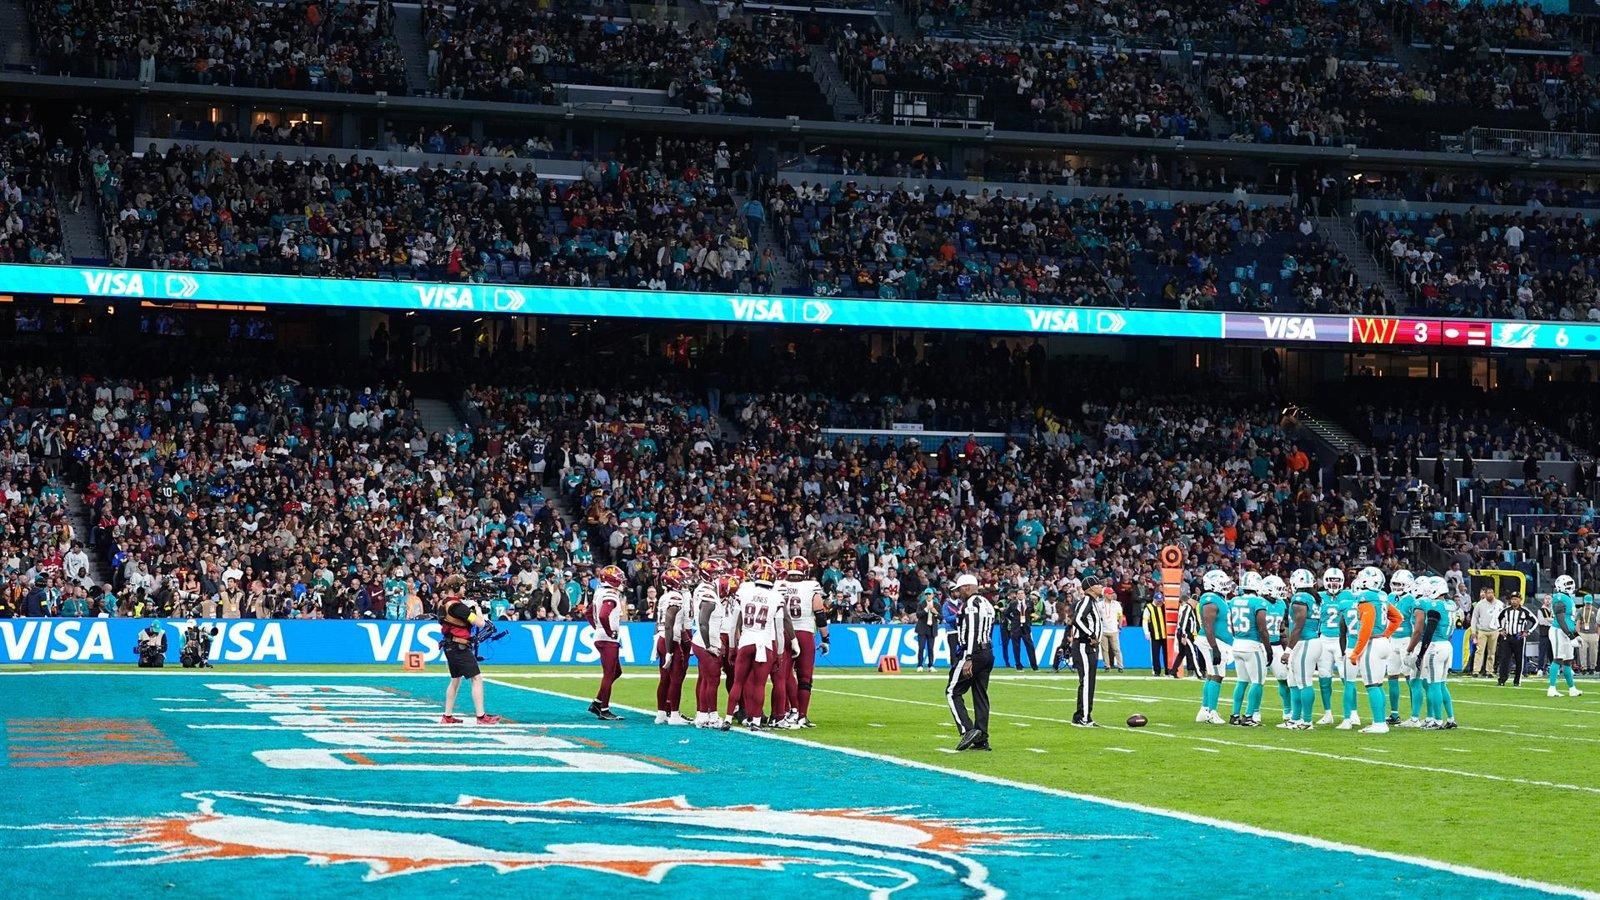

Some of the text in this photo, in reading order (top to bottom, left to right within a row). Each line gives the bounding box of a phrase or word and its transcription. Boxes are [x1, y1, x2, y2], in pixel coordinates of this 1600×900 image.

[54, 153, 65, 163] 54
[80, 271, 145, 296] VISA
[413, 286, 474, 309] VISA
[728, 298, 785, 321] VISA
[1025, 309, 1079, 331] VISA
[1258, 316, 1317, 340] VISA
[1414, 322, 1428, 342] 3
[1556, 327, 1569, 347] 6
[534, 443, 545, 455] 37
[603, 454, 612, 463] 21
[163, 487, 173, 498] 10
[889, 584, 899, 596] 44
[495, 607, 505, 617] 17
[744, 603, 769, 629] 84
[1231, 607, 1250, 633] 25
[1324, 608, 1337, 628] 2
[0, 621, 114, 661] VISA
[167, 621, 288, 662] ISA
[357, 622, 447, 662] VIS
[409, 654, 420, 668] G
[884, 657, 898, 671] 10
